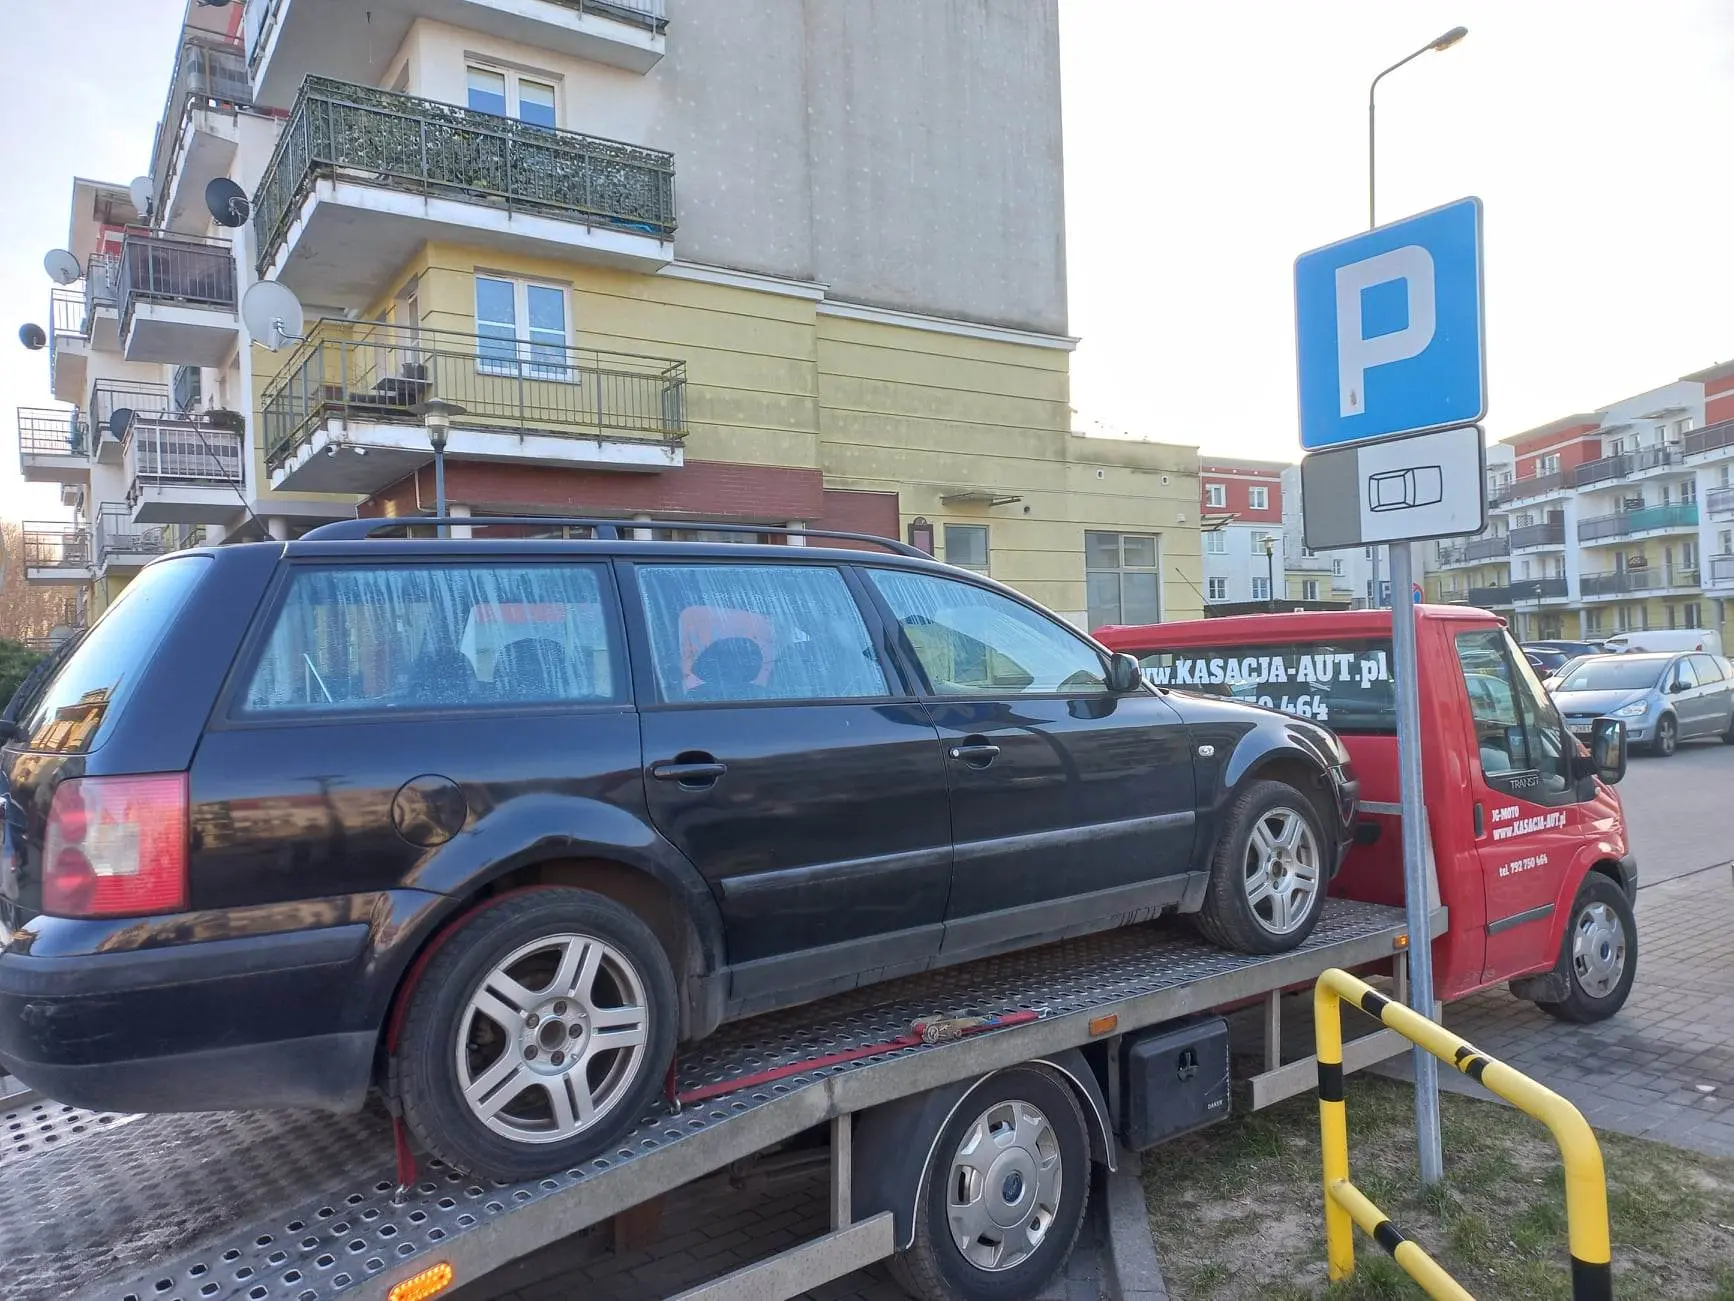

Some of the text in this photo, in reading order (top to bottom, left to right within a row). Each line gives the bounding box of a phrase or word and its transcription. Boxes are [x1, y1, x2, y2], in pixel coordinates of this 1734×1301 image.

[1335, 245, 1436, 417] P
[1510, 777, 1539, 789] TRANSIT
[1493, 811, 1566, 840] www.KASACJA-AUT.pl
[1510, 860, 1523, 874] 792
[1523, 857, 1536, 870] 750
[1535, 853, 1548, 866] 464
